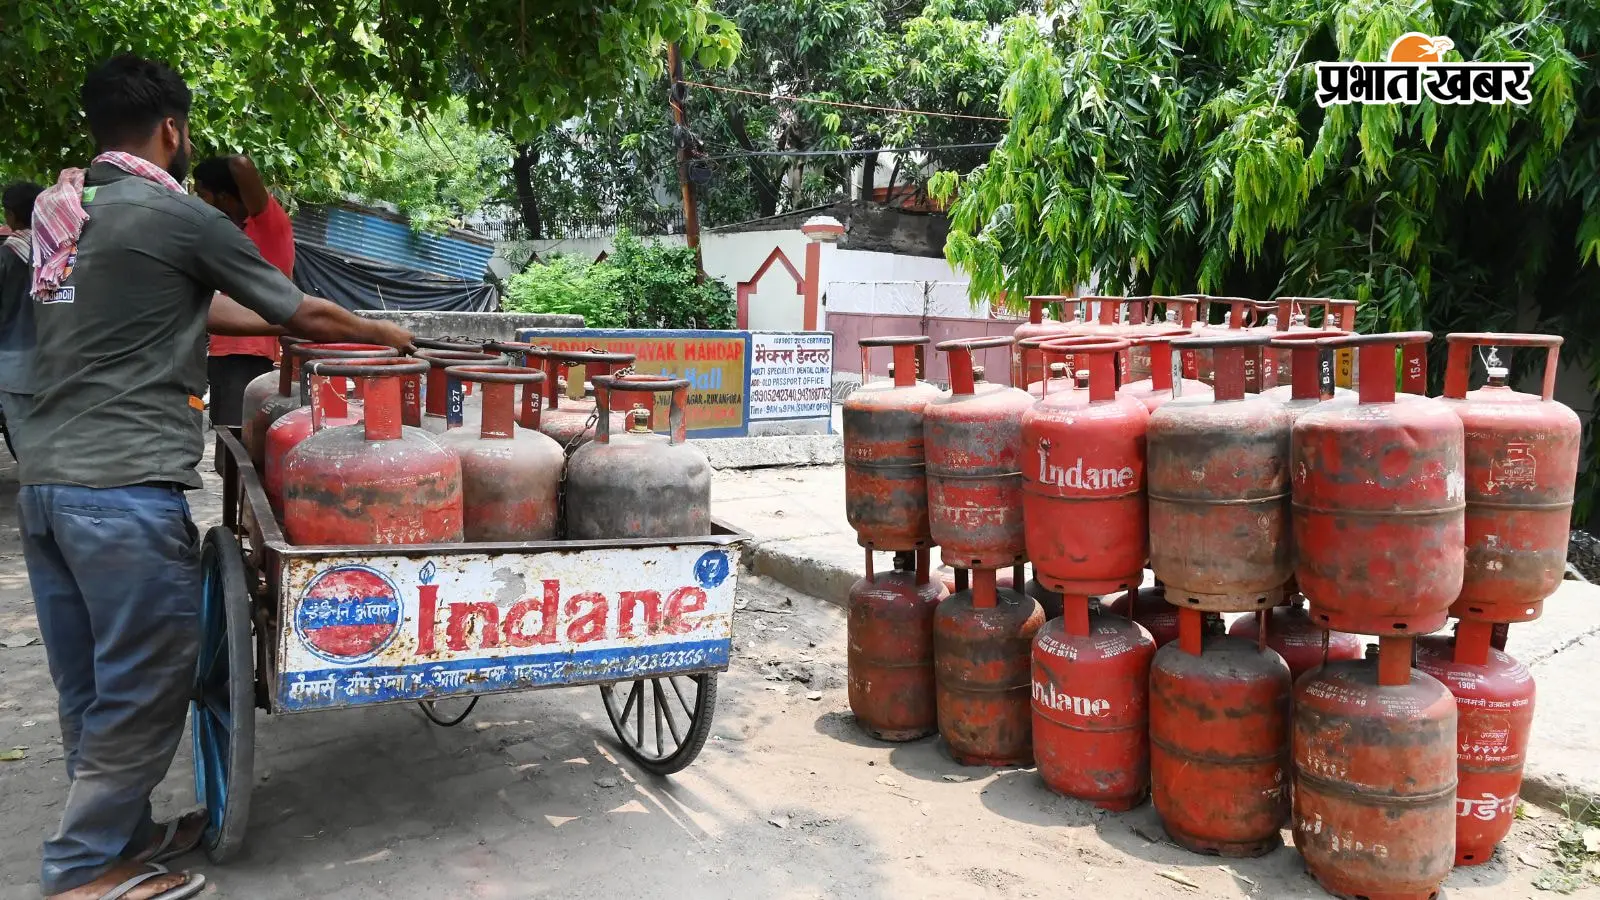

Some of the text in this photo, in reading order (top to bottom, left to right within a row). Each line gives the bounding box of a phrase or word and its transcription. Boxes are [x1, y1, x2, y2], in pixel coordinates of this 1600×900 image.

[685, 341, 742, 361] MANDAP
[807, 337, 830, 345] CERTIFIED
[767, 367, 795, 375] SPECIALITY
[797, 366, 814, 374] DENTAL
[815, 366, 830, 374] CLINIC
[1245, 359, 1255, 382] 15.8
[1322, 360, 1330, 385] B.30
[1409, 357, 1420, 379] 15.4
[762, 378, 772, 386] OLD
[773, 377, 801, 386] PASSPORT
[803, 376, 825, 385] OFFICE
[453, 390, 461, 413] C.27
[531, 392, 540, 413] 15.8
[1038, 446, 1134, 490] Indane
[414, 579, 708, 655] Indane
[1457, 681, 1476, 690] 1906
